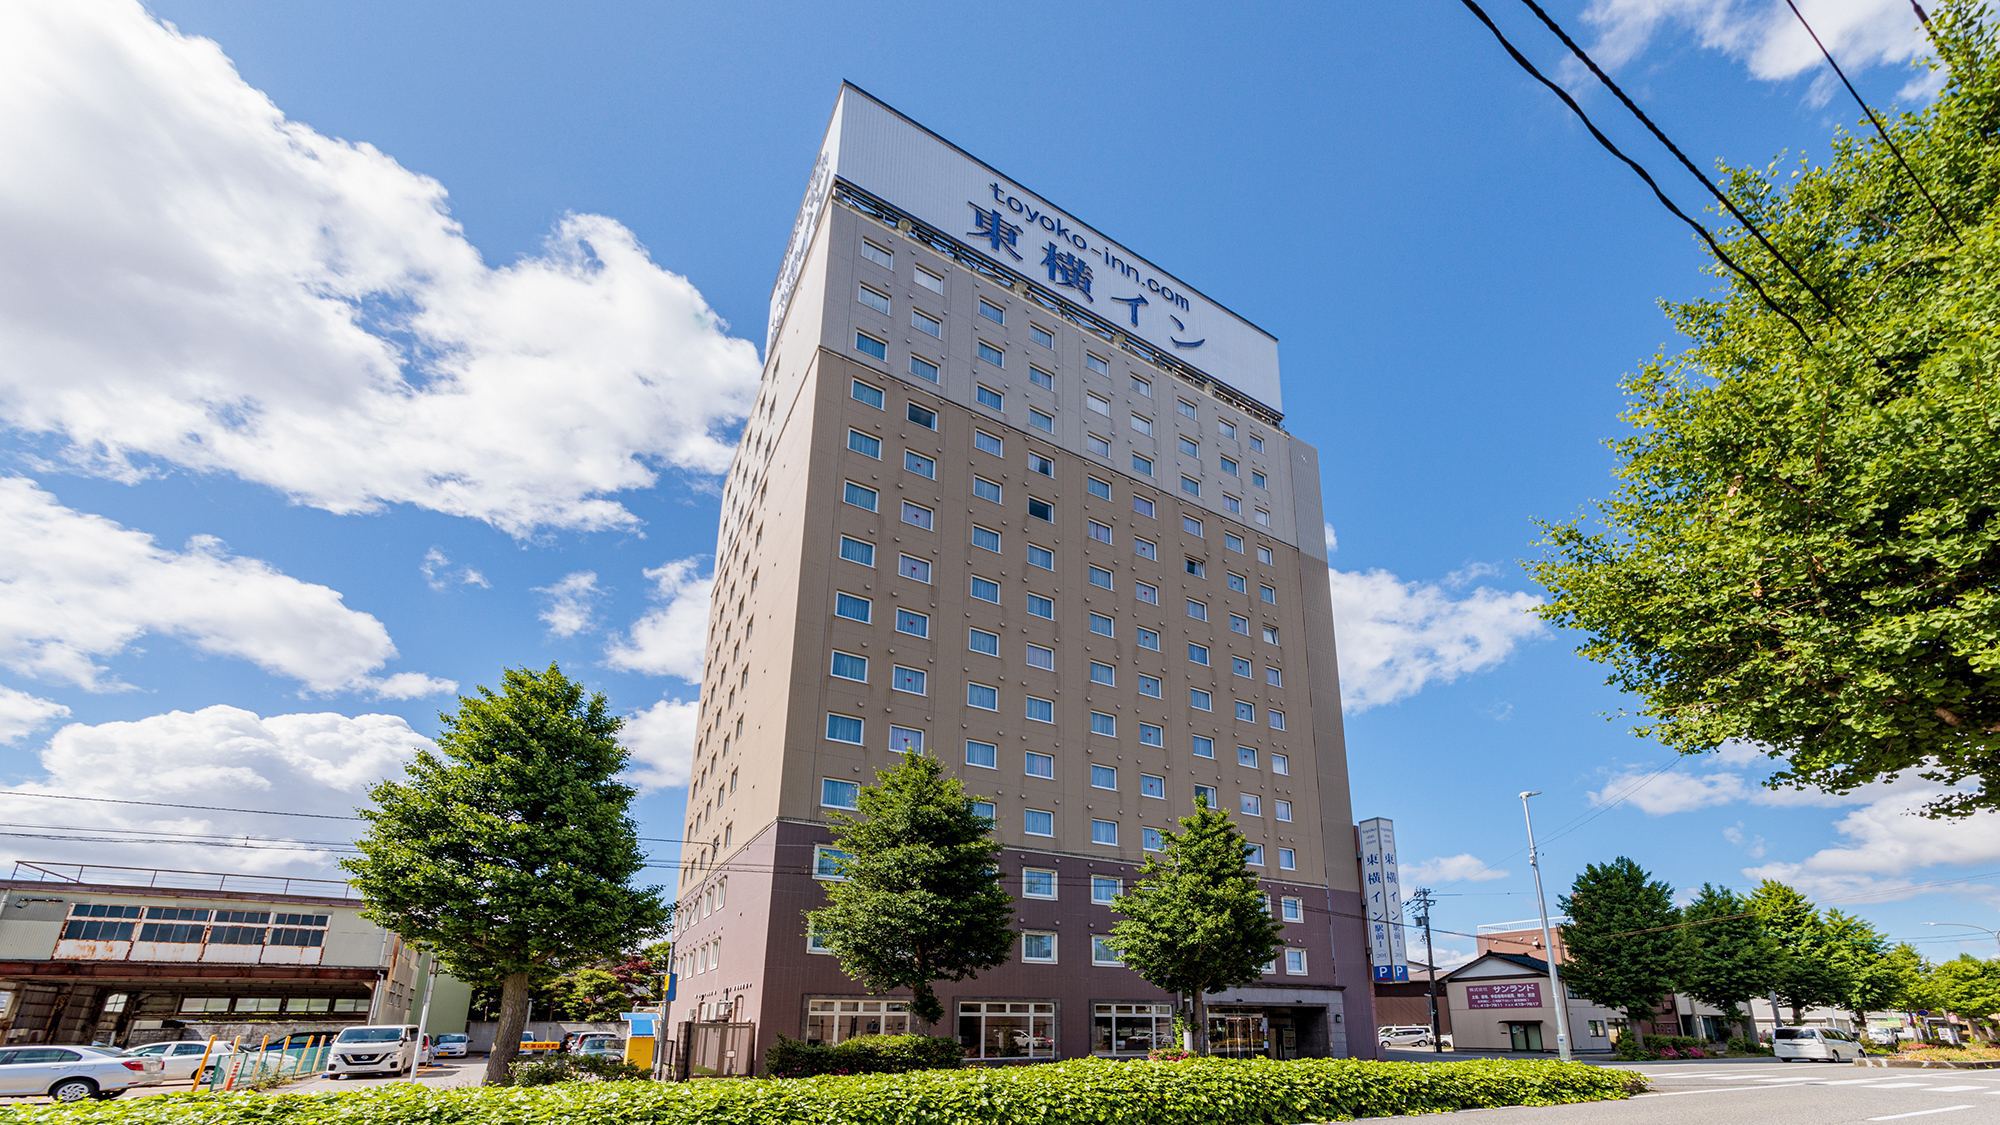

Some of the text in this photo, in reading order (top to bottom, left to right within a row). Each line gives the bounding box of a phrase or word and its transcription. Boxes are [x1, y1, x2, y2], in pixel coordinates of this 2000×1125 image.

[966, 201, 1205, 347] 東横イン
[989, 182, 1190, 312] toyoko-inn.com
[1367, 853, 1383, 921] 東横イン
[1385, 853, 1399, 921] 東横イン
[1379, 966, 1388, 978] P
[1396, 965, 1403, 977] P
[1493, 984, 1535, 993] サンランド
